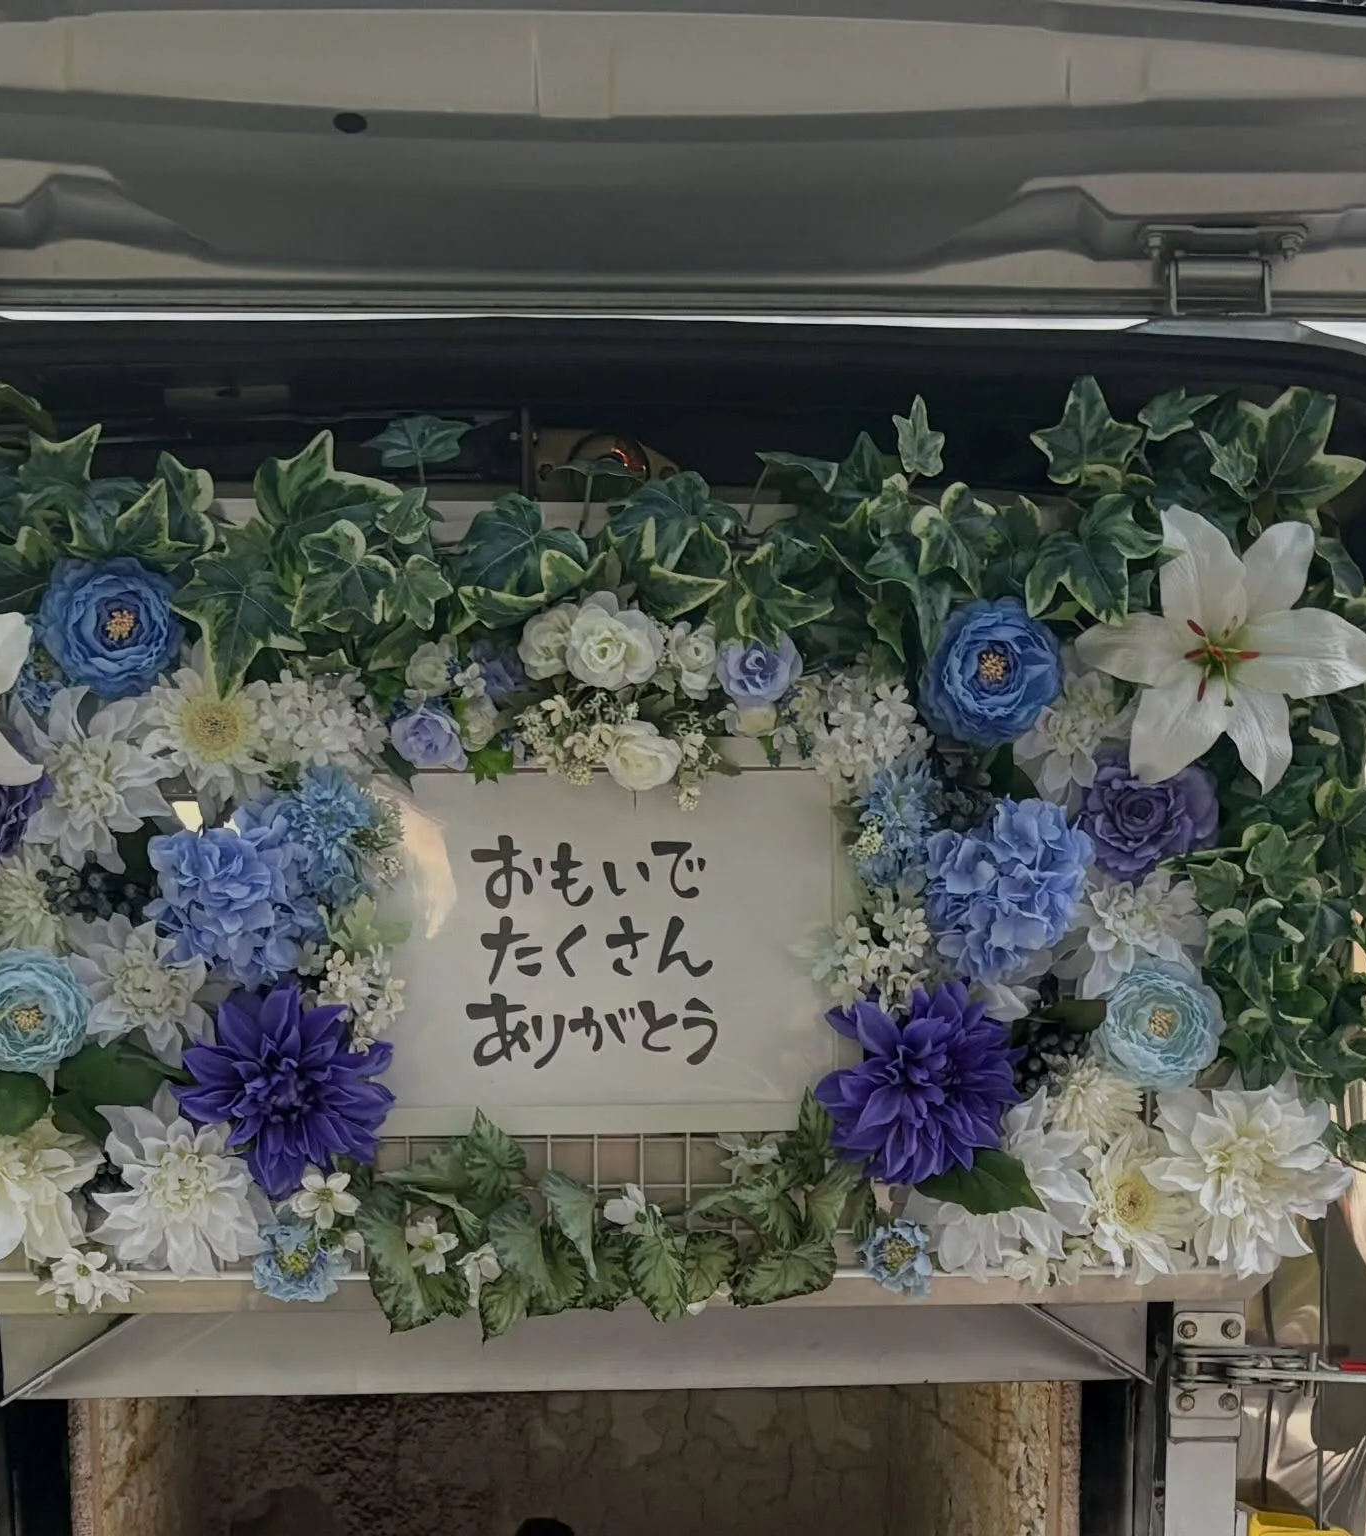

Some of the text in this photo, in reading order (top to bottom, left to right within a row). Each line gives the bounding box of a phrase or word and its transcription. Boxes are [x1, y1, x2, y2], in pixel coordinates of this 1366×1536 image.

[471, 834, 706, 908] おもいで
[480, 916, 713, 985] たくさん
[466, 993, 718, 1069] ありがとう
